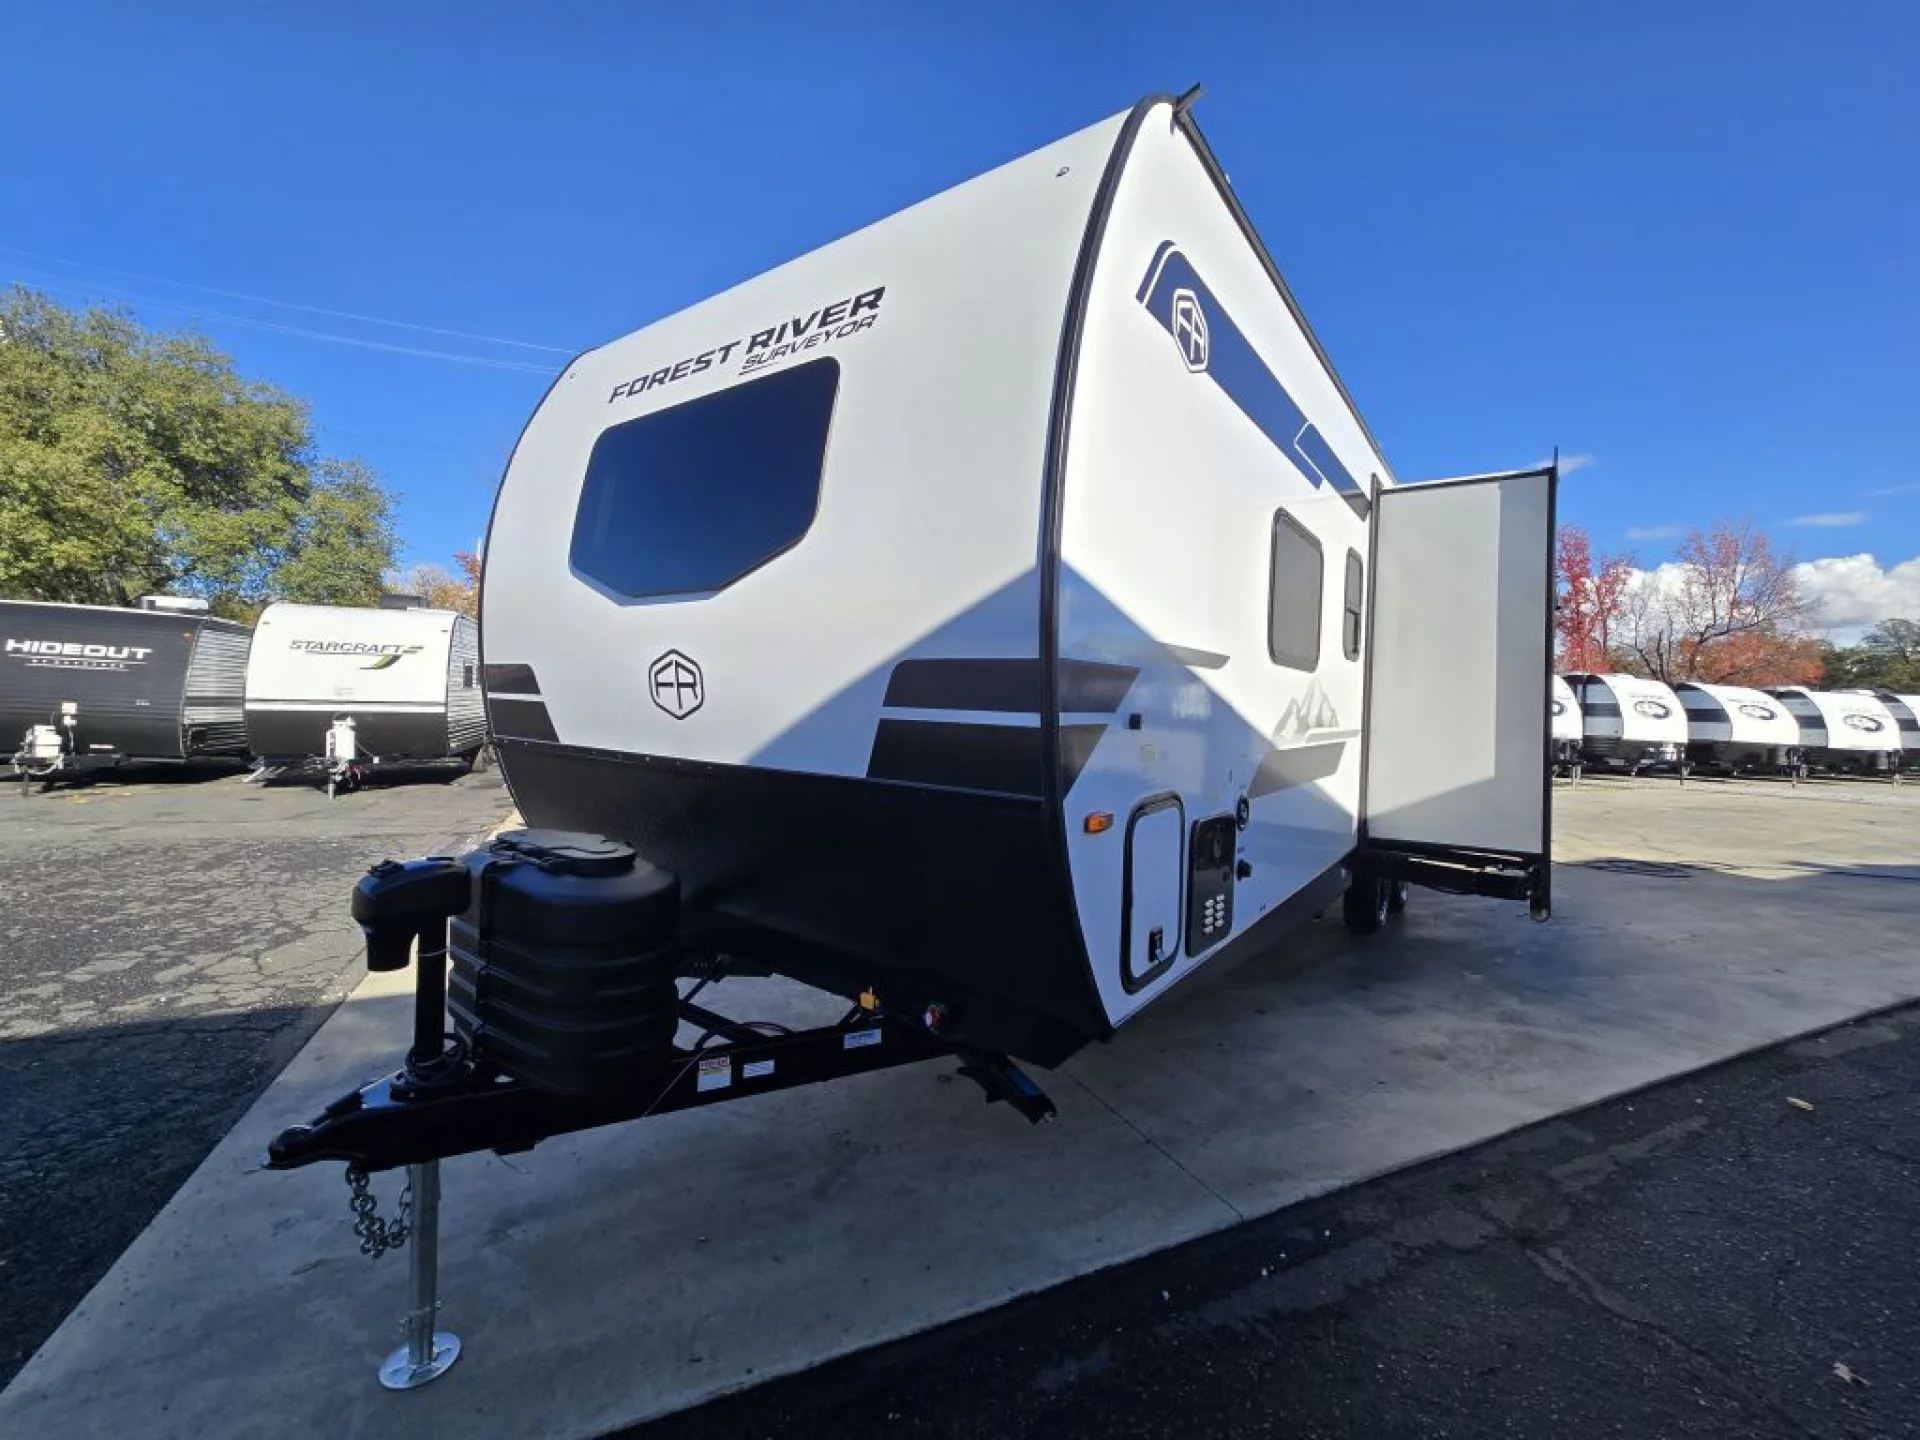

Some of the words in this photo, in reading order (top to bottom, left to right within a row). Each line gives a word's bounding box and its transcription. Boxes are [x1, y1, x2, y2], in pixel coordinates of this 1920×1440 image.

[608, 340, 742, 404] FOREST
[746, 285, 886, 354] RIVER
[741, 313, 878, 370] SURVEYOR
[5, 639, 152, 659] HIDEOUT
[290, 639, 405, 654] STARCRAFT
